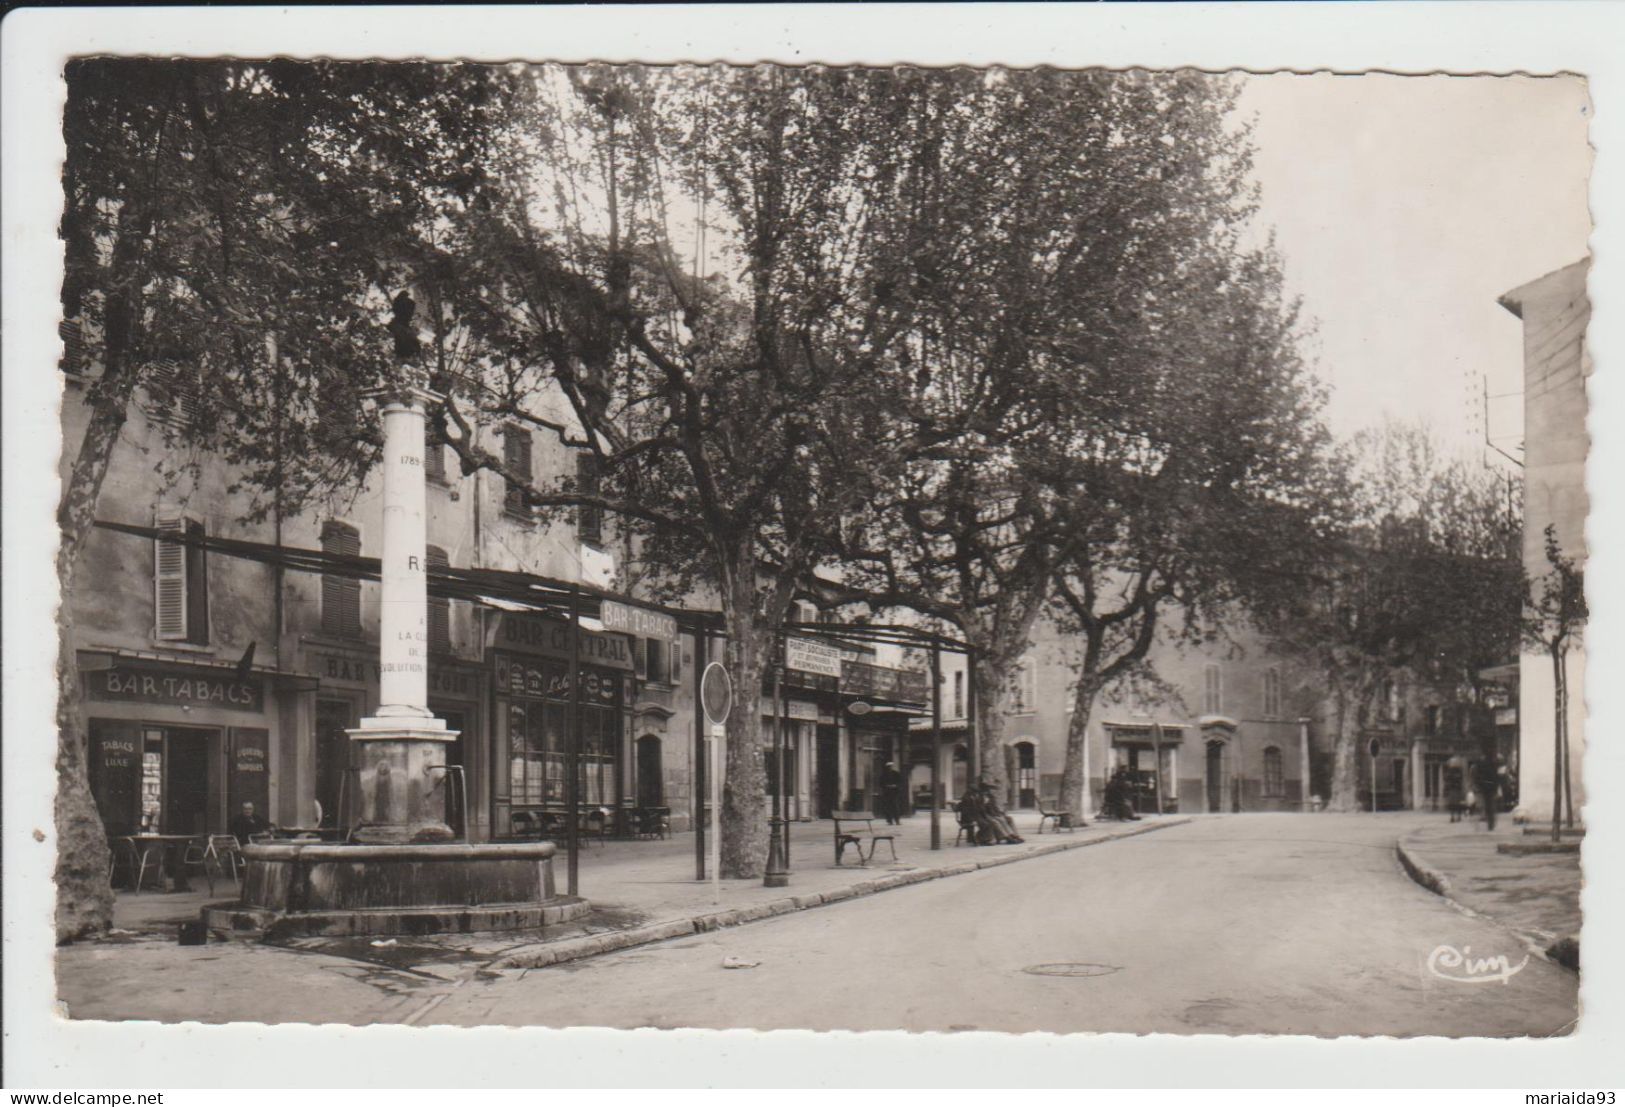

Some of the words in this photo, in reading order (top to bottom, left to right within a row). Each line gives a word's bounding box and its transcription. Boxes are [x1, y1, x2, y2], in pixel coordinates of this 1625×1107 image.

[505, 617, 543, 646] BAR
[327, 658, 365, 682] BAR
[163, 677, 253, 704] TABACS
[101, 740, 134, 752] TABACS
[104, 757, 129, 767] LUXE
